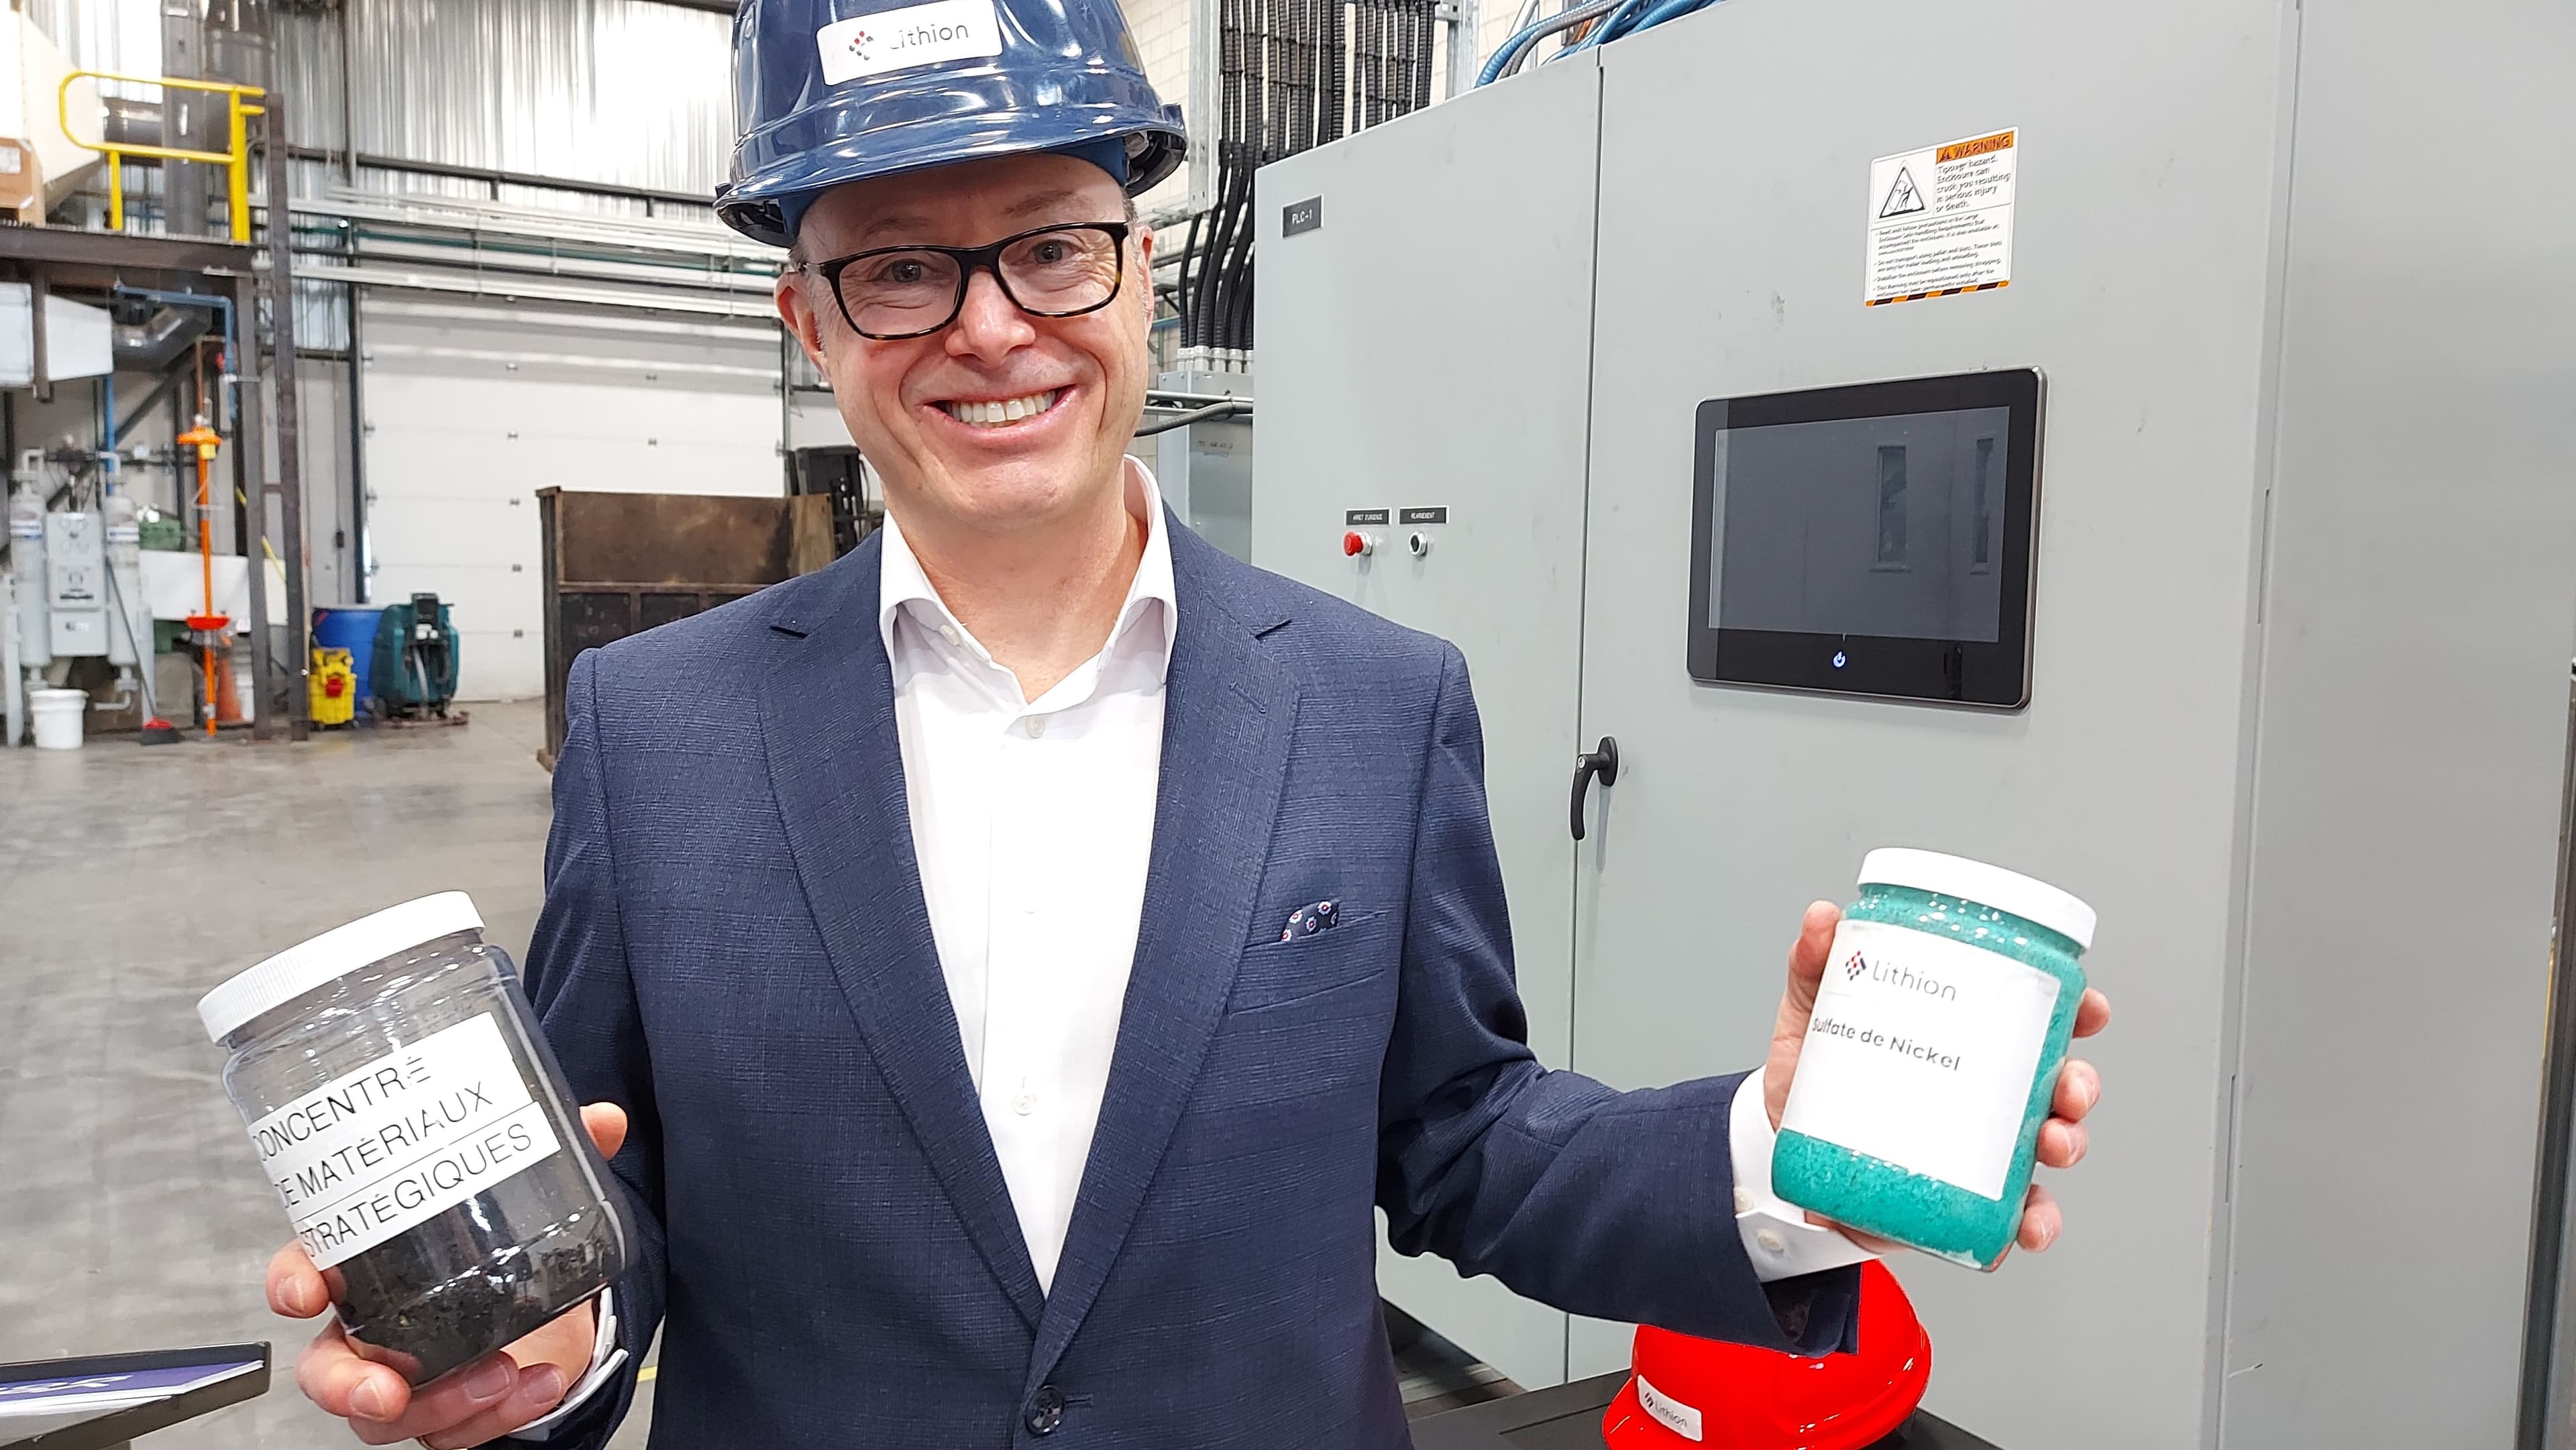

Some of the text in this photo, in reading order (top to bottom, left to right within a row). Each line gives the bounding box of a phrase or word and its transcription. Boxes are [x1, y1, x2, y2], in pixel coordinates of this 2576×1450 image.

[1955, 135, 2010, 158] WARNING
[1292, 209, 1312, 225] PLC-1
[1872, 960, 1957, 1001] Lithion
[1860, 1029, 1884, 1046] de
[1889, 1036, 1961, 1071] Nickel
[295, 1081, 493, 1199] MATÉRIAUX
[300, 1123, 531, 1258] STRATÉGIQUES
